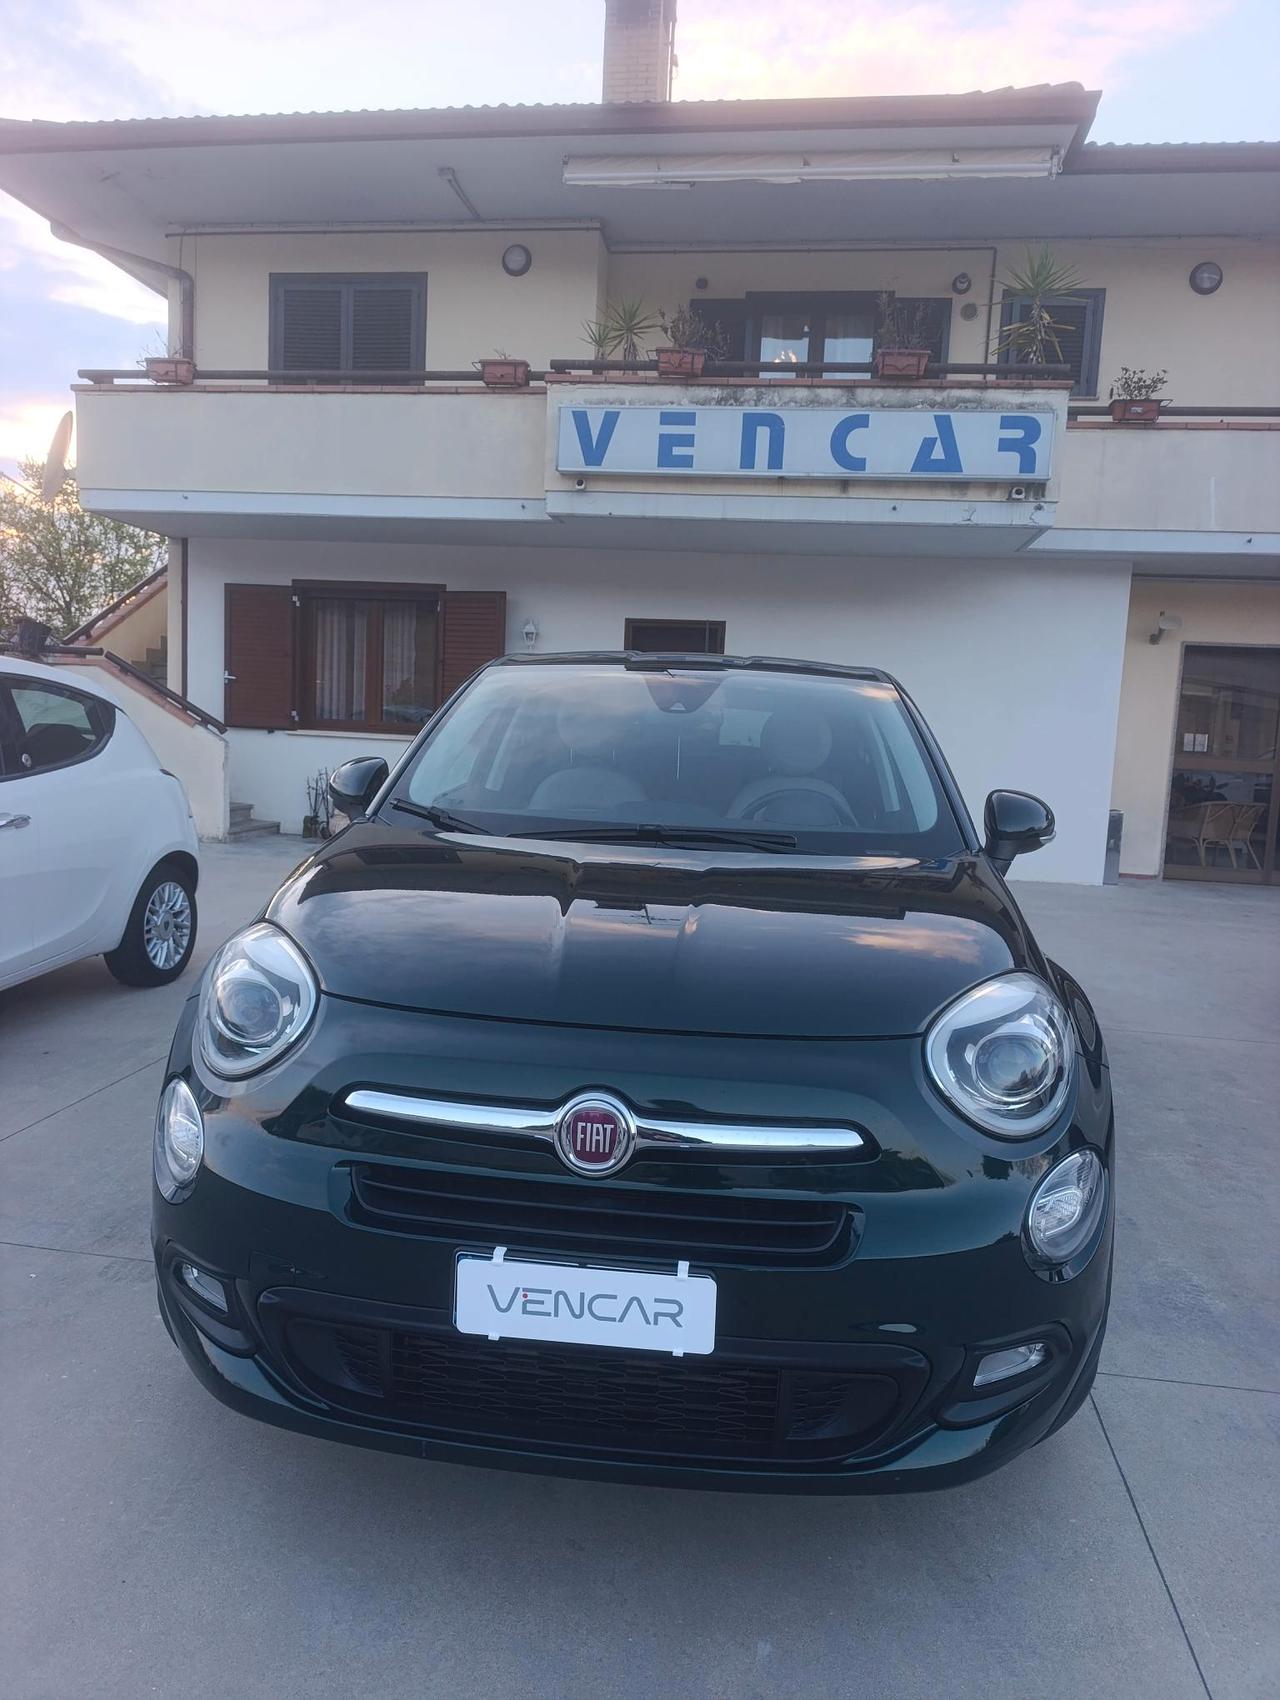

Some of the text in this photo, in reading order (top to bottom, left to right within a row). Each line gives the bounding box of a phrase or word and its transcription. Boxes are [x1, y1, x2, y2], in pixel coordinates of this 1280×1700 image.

[571, 410, 1042, 474] VENCAR
[576, 1121, 615, 1153] FIAT
[487, 1284, 684, 1328] VENCAR
